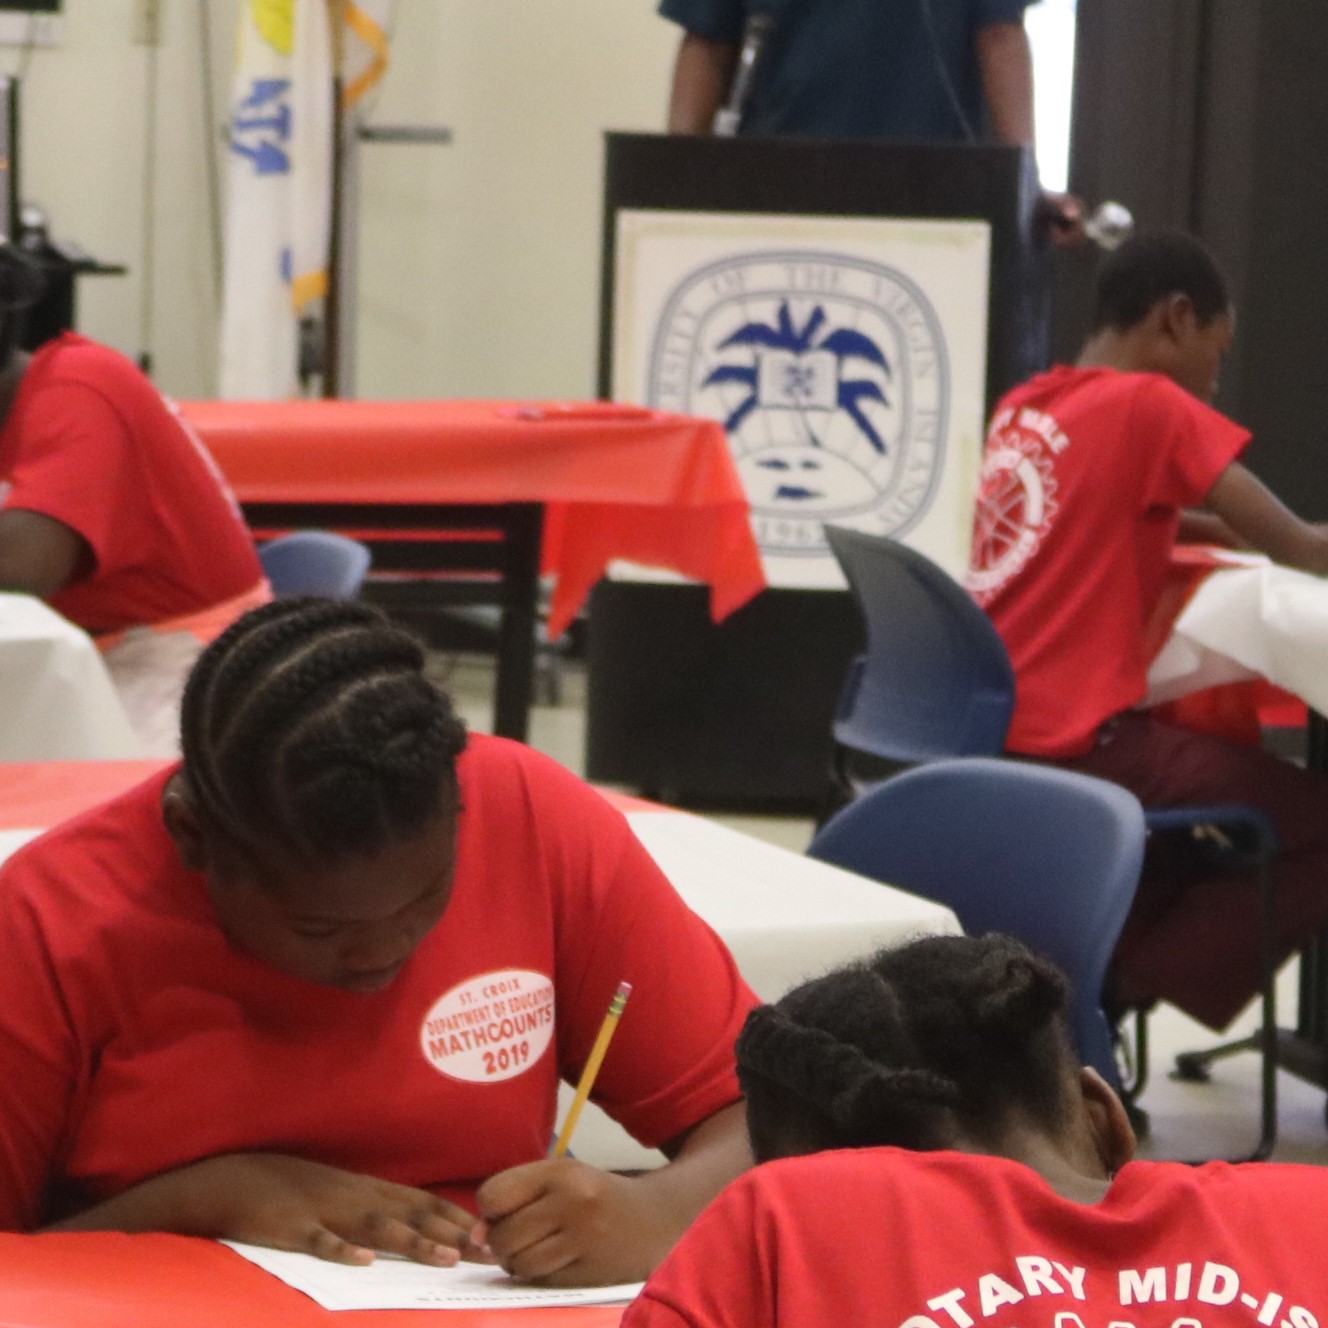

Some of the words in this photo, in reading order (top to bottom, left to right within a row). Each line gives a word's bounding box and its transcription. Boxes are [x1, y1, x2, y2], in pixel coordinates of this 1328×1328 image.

[788, 264, 840, 290] THE
[459, 992, 479, 1006] ST.
[482, 978, 522, 999] CROIX
[426, 1005, 491, 1036] DEPARTMENT
[493, 1002, 507, 1017] OF
[429, 1003, 553, 1059] MATHCOUNTS
[482, 1040, 530, 1075] 2019
